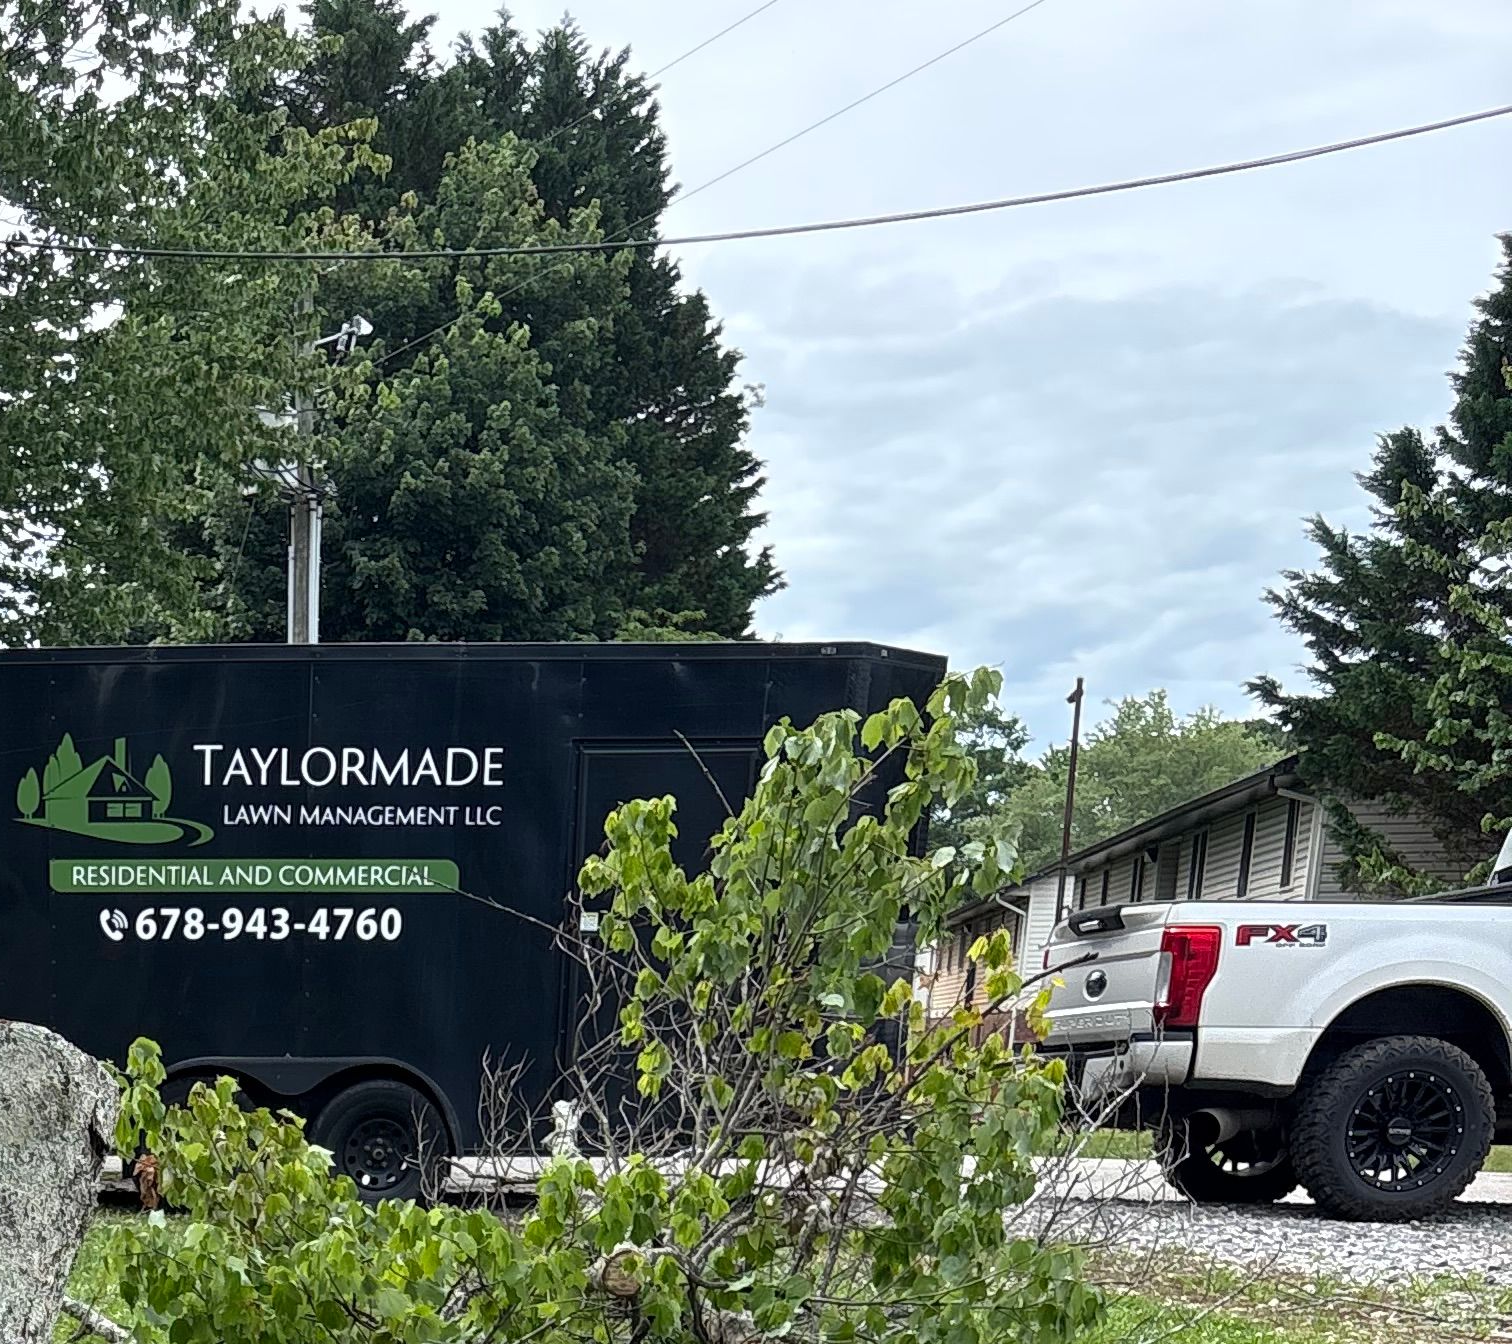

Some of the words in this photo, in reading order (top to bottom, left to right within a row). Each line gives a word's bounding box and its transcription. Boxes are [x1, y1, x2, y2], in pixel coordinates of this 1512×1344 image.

[192, 744, 504, 787] TAYLORMADE
[223, 804, 292, 825] LAWN
[299, 805, 459, 826] MANAGEMENT
[465, 805, 502, 826] LLC
[72, 865, 214, 886] RESIDENTIAL
[219, 865, 272, 886] AND
[278, 865, 435, 886] COMMERCIAL
[135, 907, 402, 941] 678-943-4760
[1235, 924, 1327, 946] FX4
